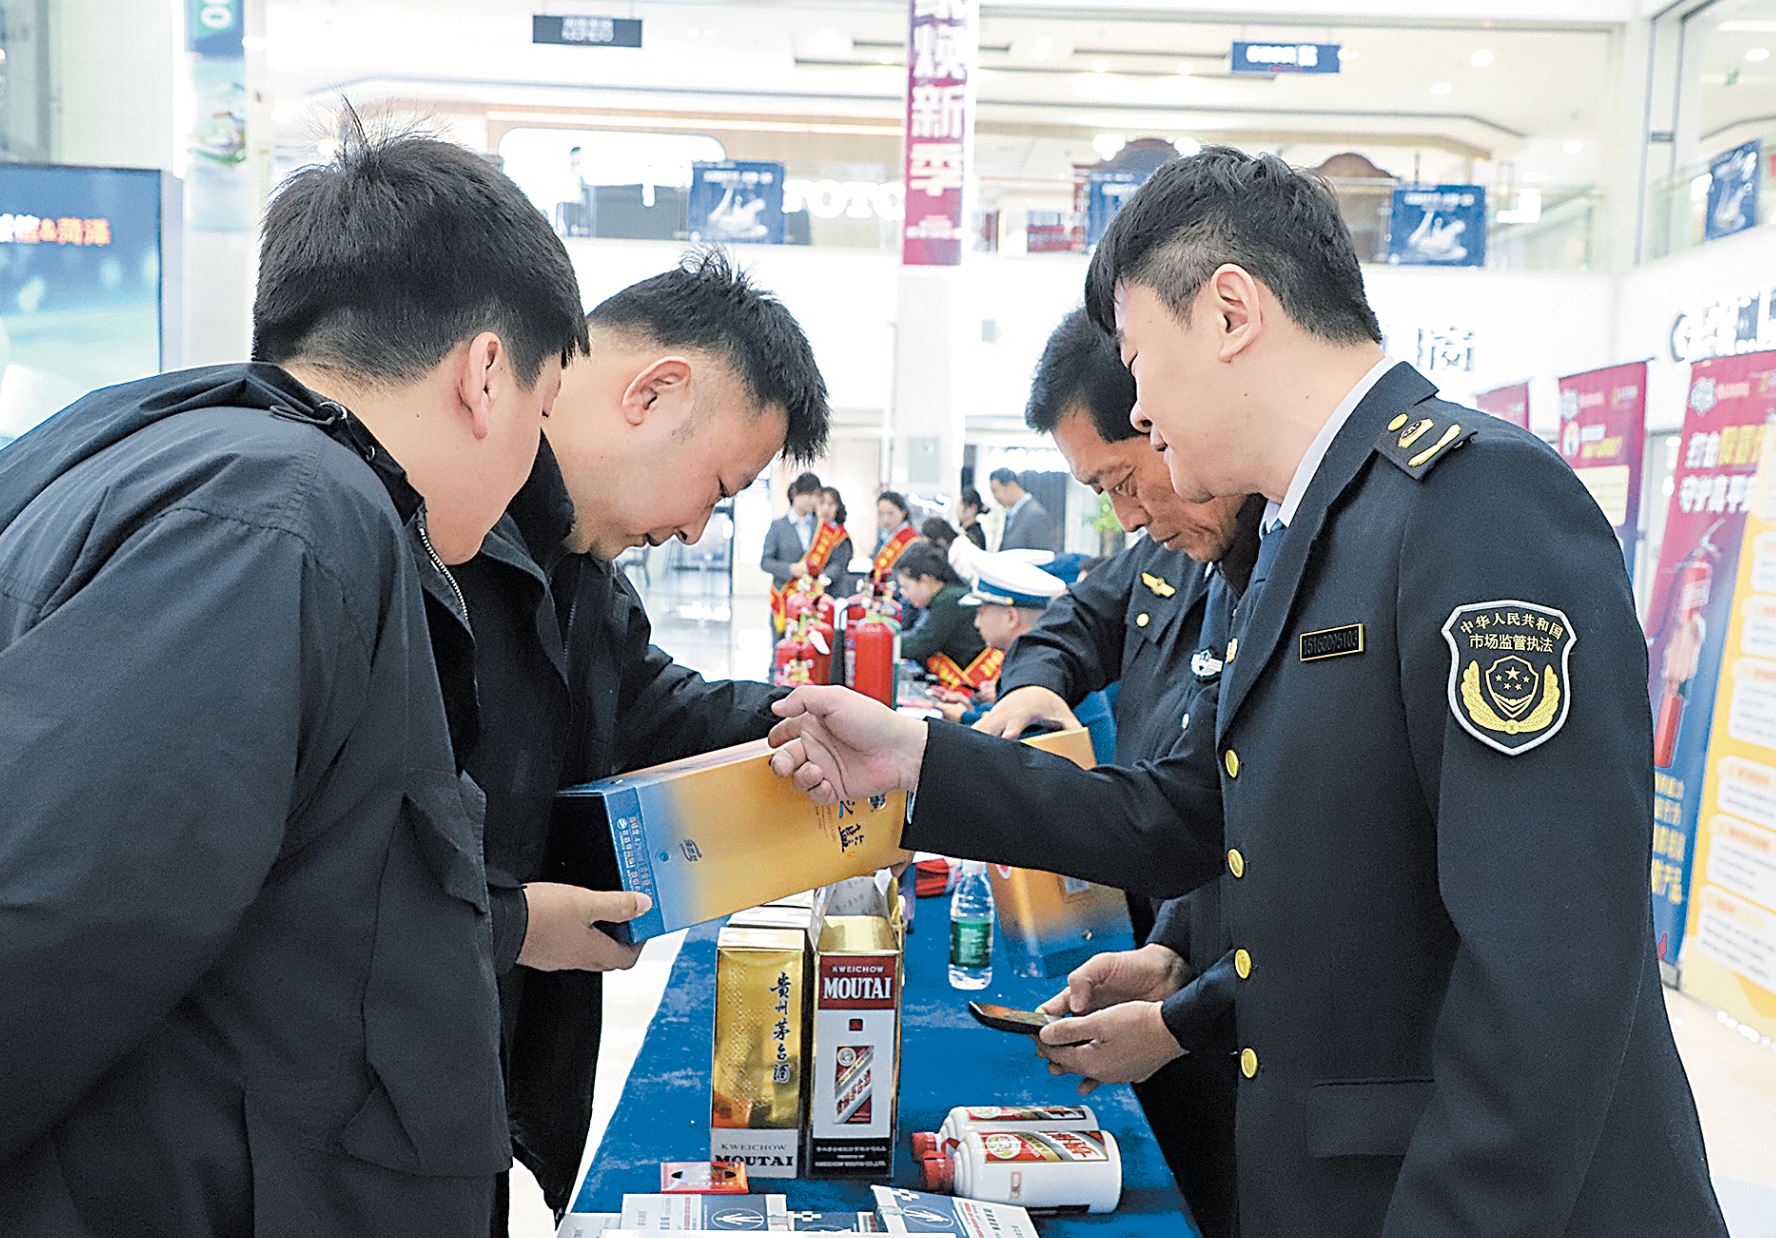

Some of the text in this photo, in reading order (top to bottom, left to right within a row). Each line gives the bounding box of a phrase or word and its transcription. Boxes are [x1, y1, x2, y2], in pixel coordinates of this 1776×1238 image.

[1460, 612, 1564, 640] 中华人民共和国
[1469, 633, 1553, 653] 市场监管执法
[832, 965, 884, 973] KWEICHOW
[823, 976, 892, 1000] MOUTAI
[715, 1154, 793, 1167] MOUTAI
